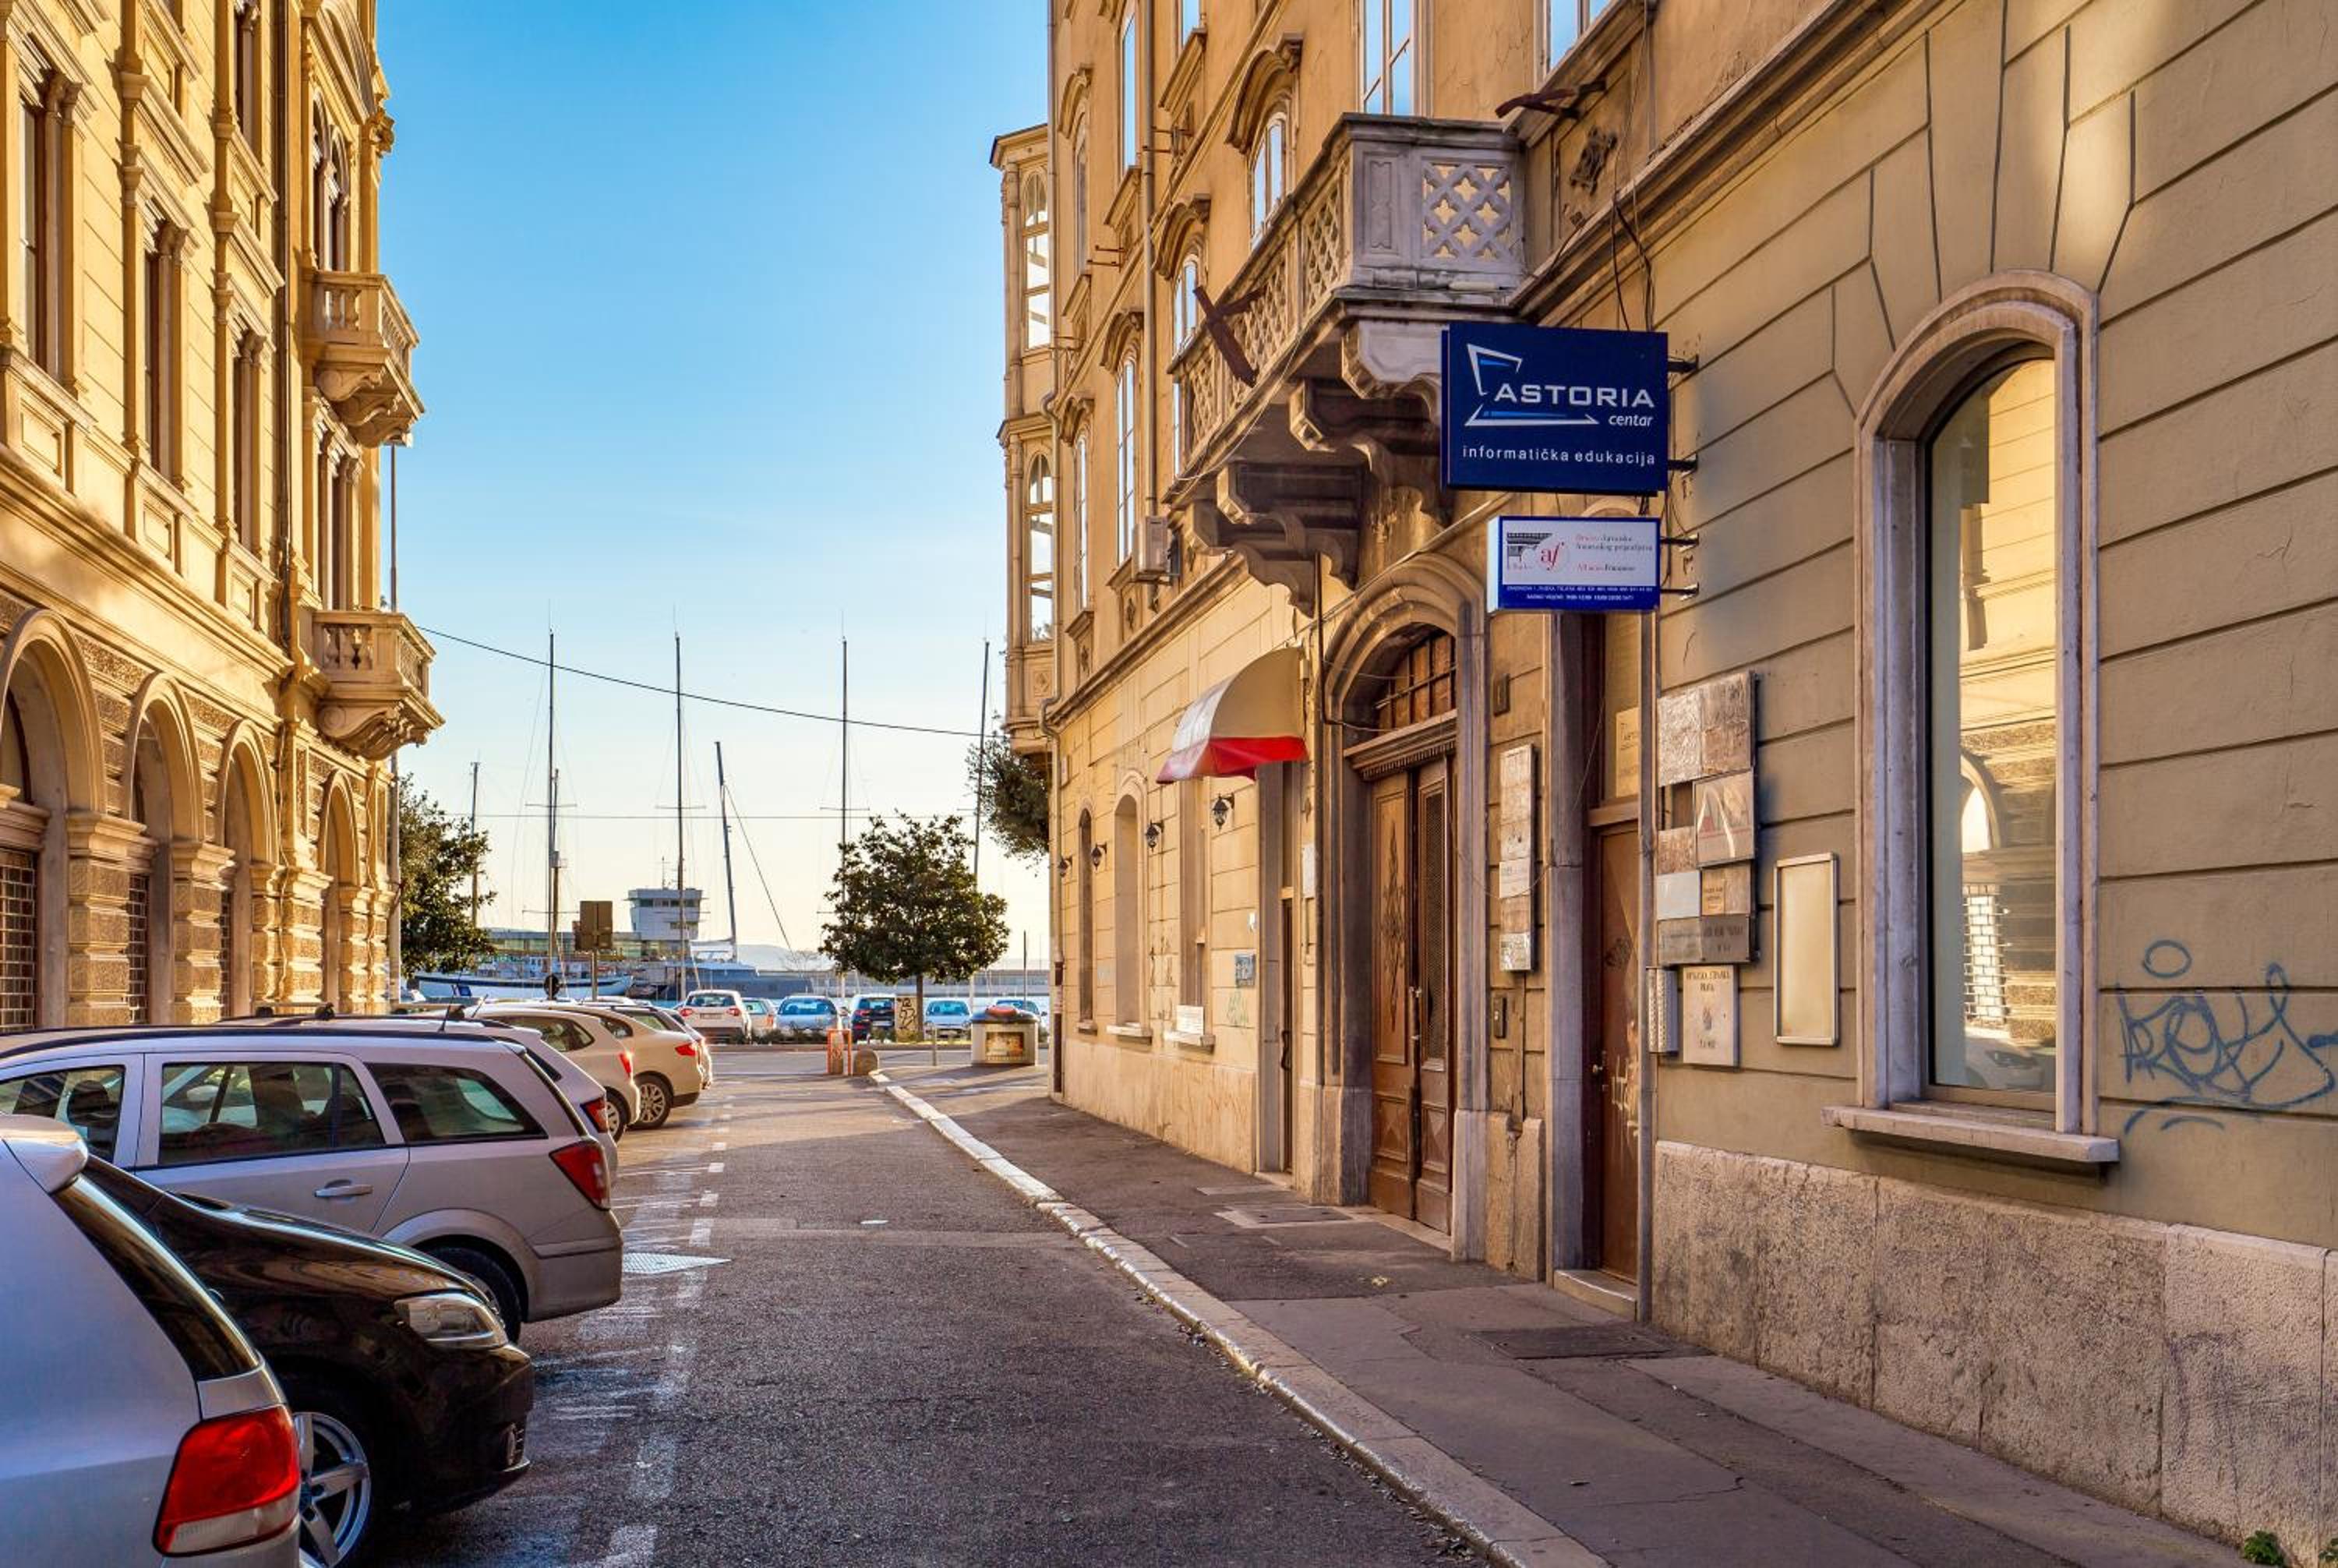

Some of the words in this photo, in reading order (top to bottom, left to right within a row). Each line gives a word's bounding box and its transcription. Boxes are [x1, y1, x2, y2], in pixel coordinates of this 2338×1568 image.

[1494, 383, 1655, 408] ASTORIA
[1608, 413, 1654, 428] centar
[1462, 444, 1569, 462] informatička
[1574, 450, 1655, 466] edukacija
